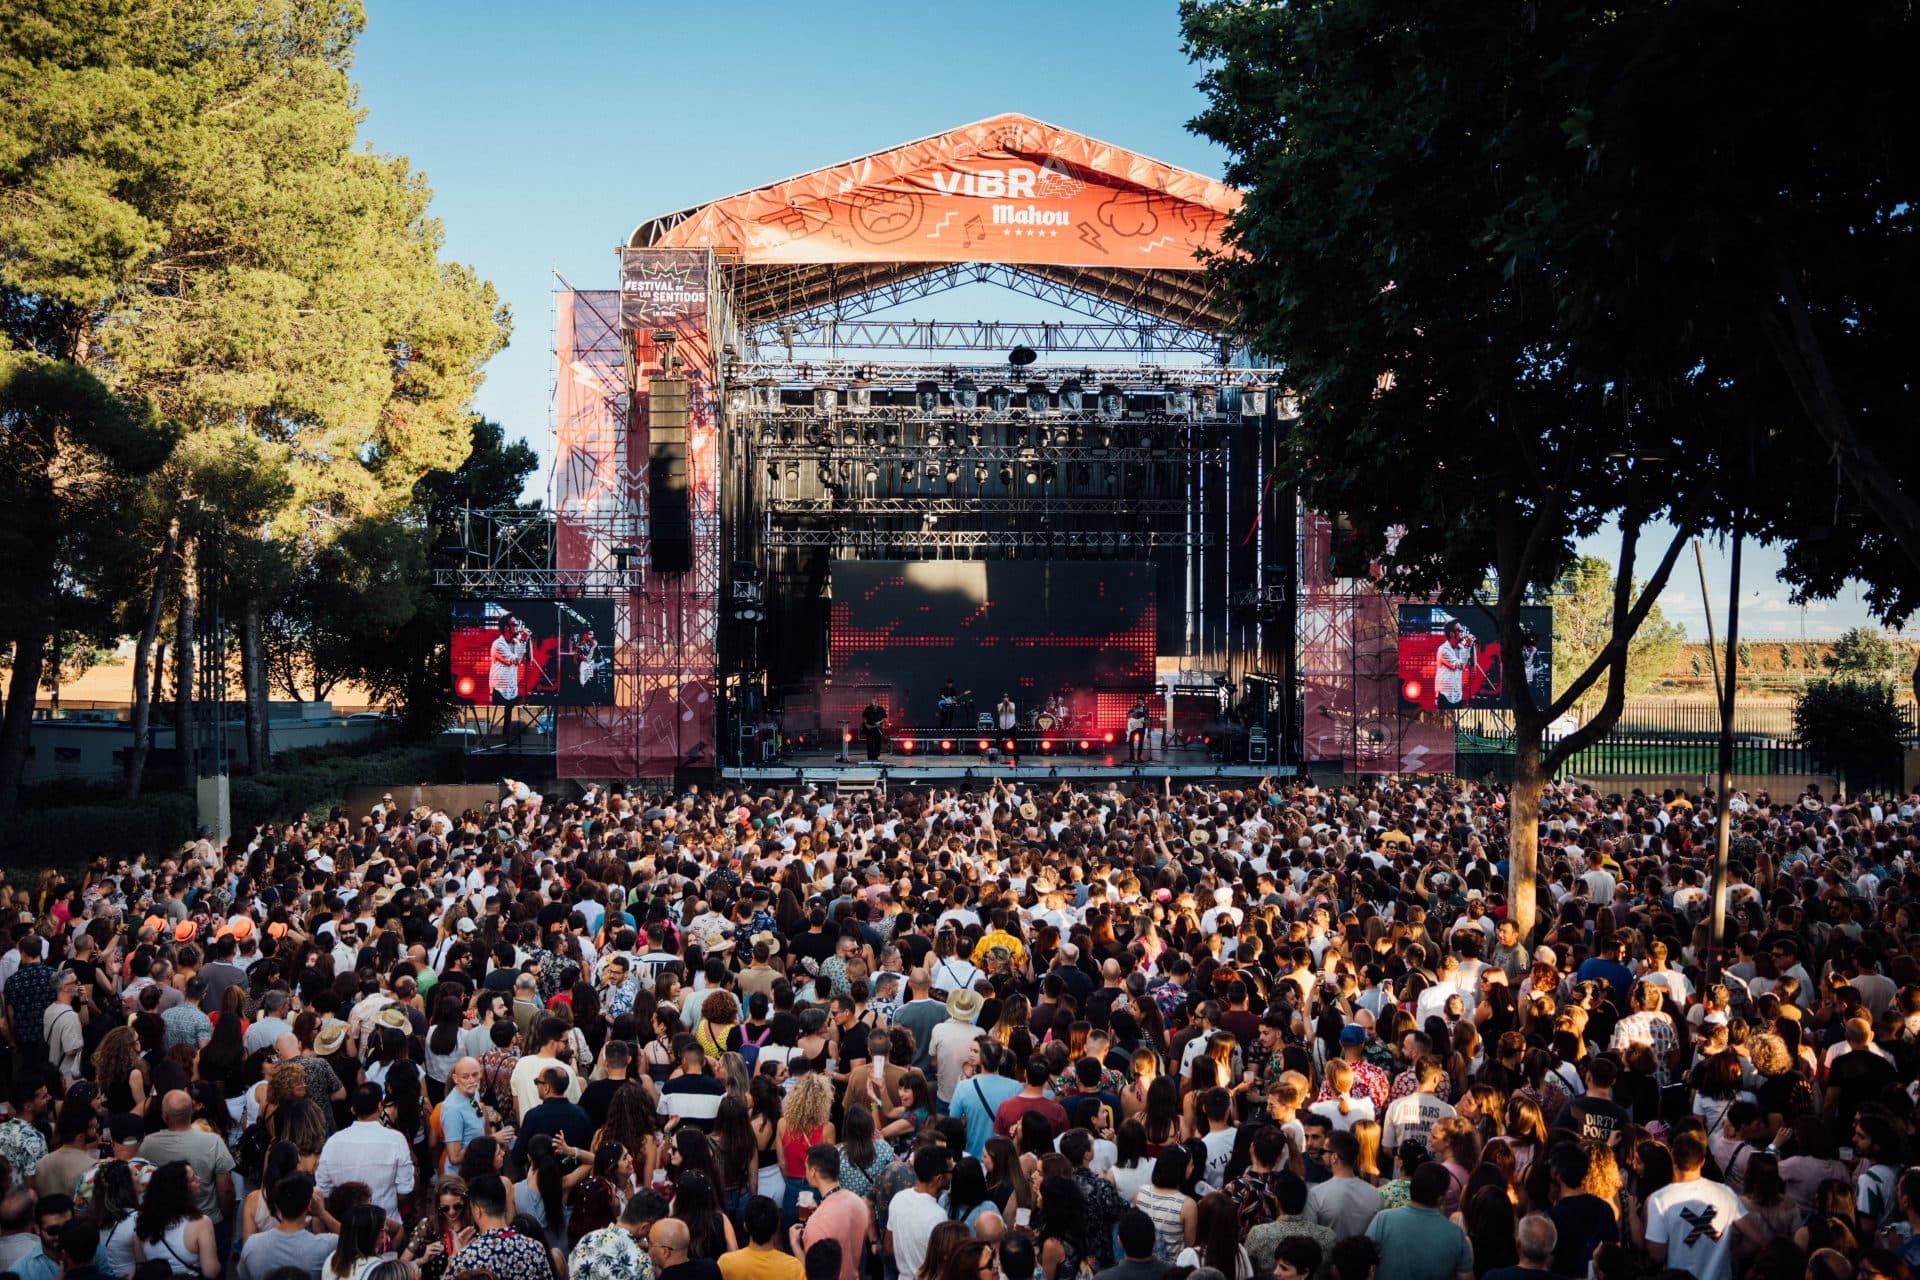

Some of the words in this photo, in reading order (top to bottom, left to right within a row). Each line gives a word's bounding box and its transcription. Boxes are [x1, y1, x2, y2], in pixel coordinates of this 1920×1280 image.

[992, 204, 1070, 226] Mahou
[624, 280, 674, 291] FESTIVAL
[652, 292, 705, 303] SENTIDOS
[1585, 1112, 1617, 1129] DIRTY
[1210, 1150, 1233, 1169] YU
